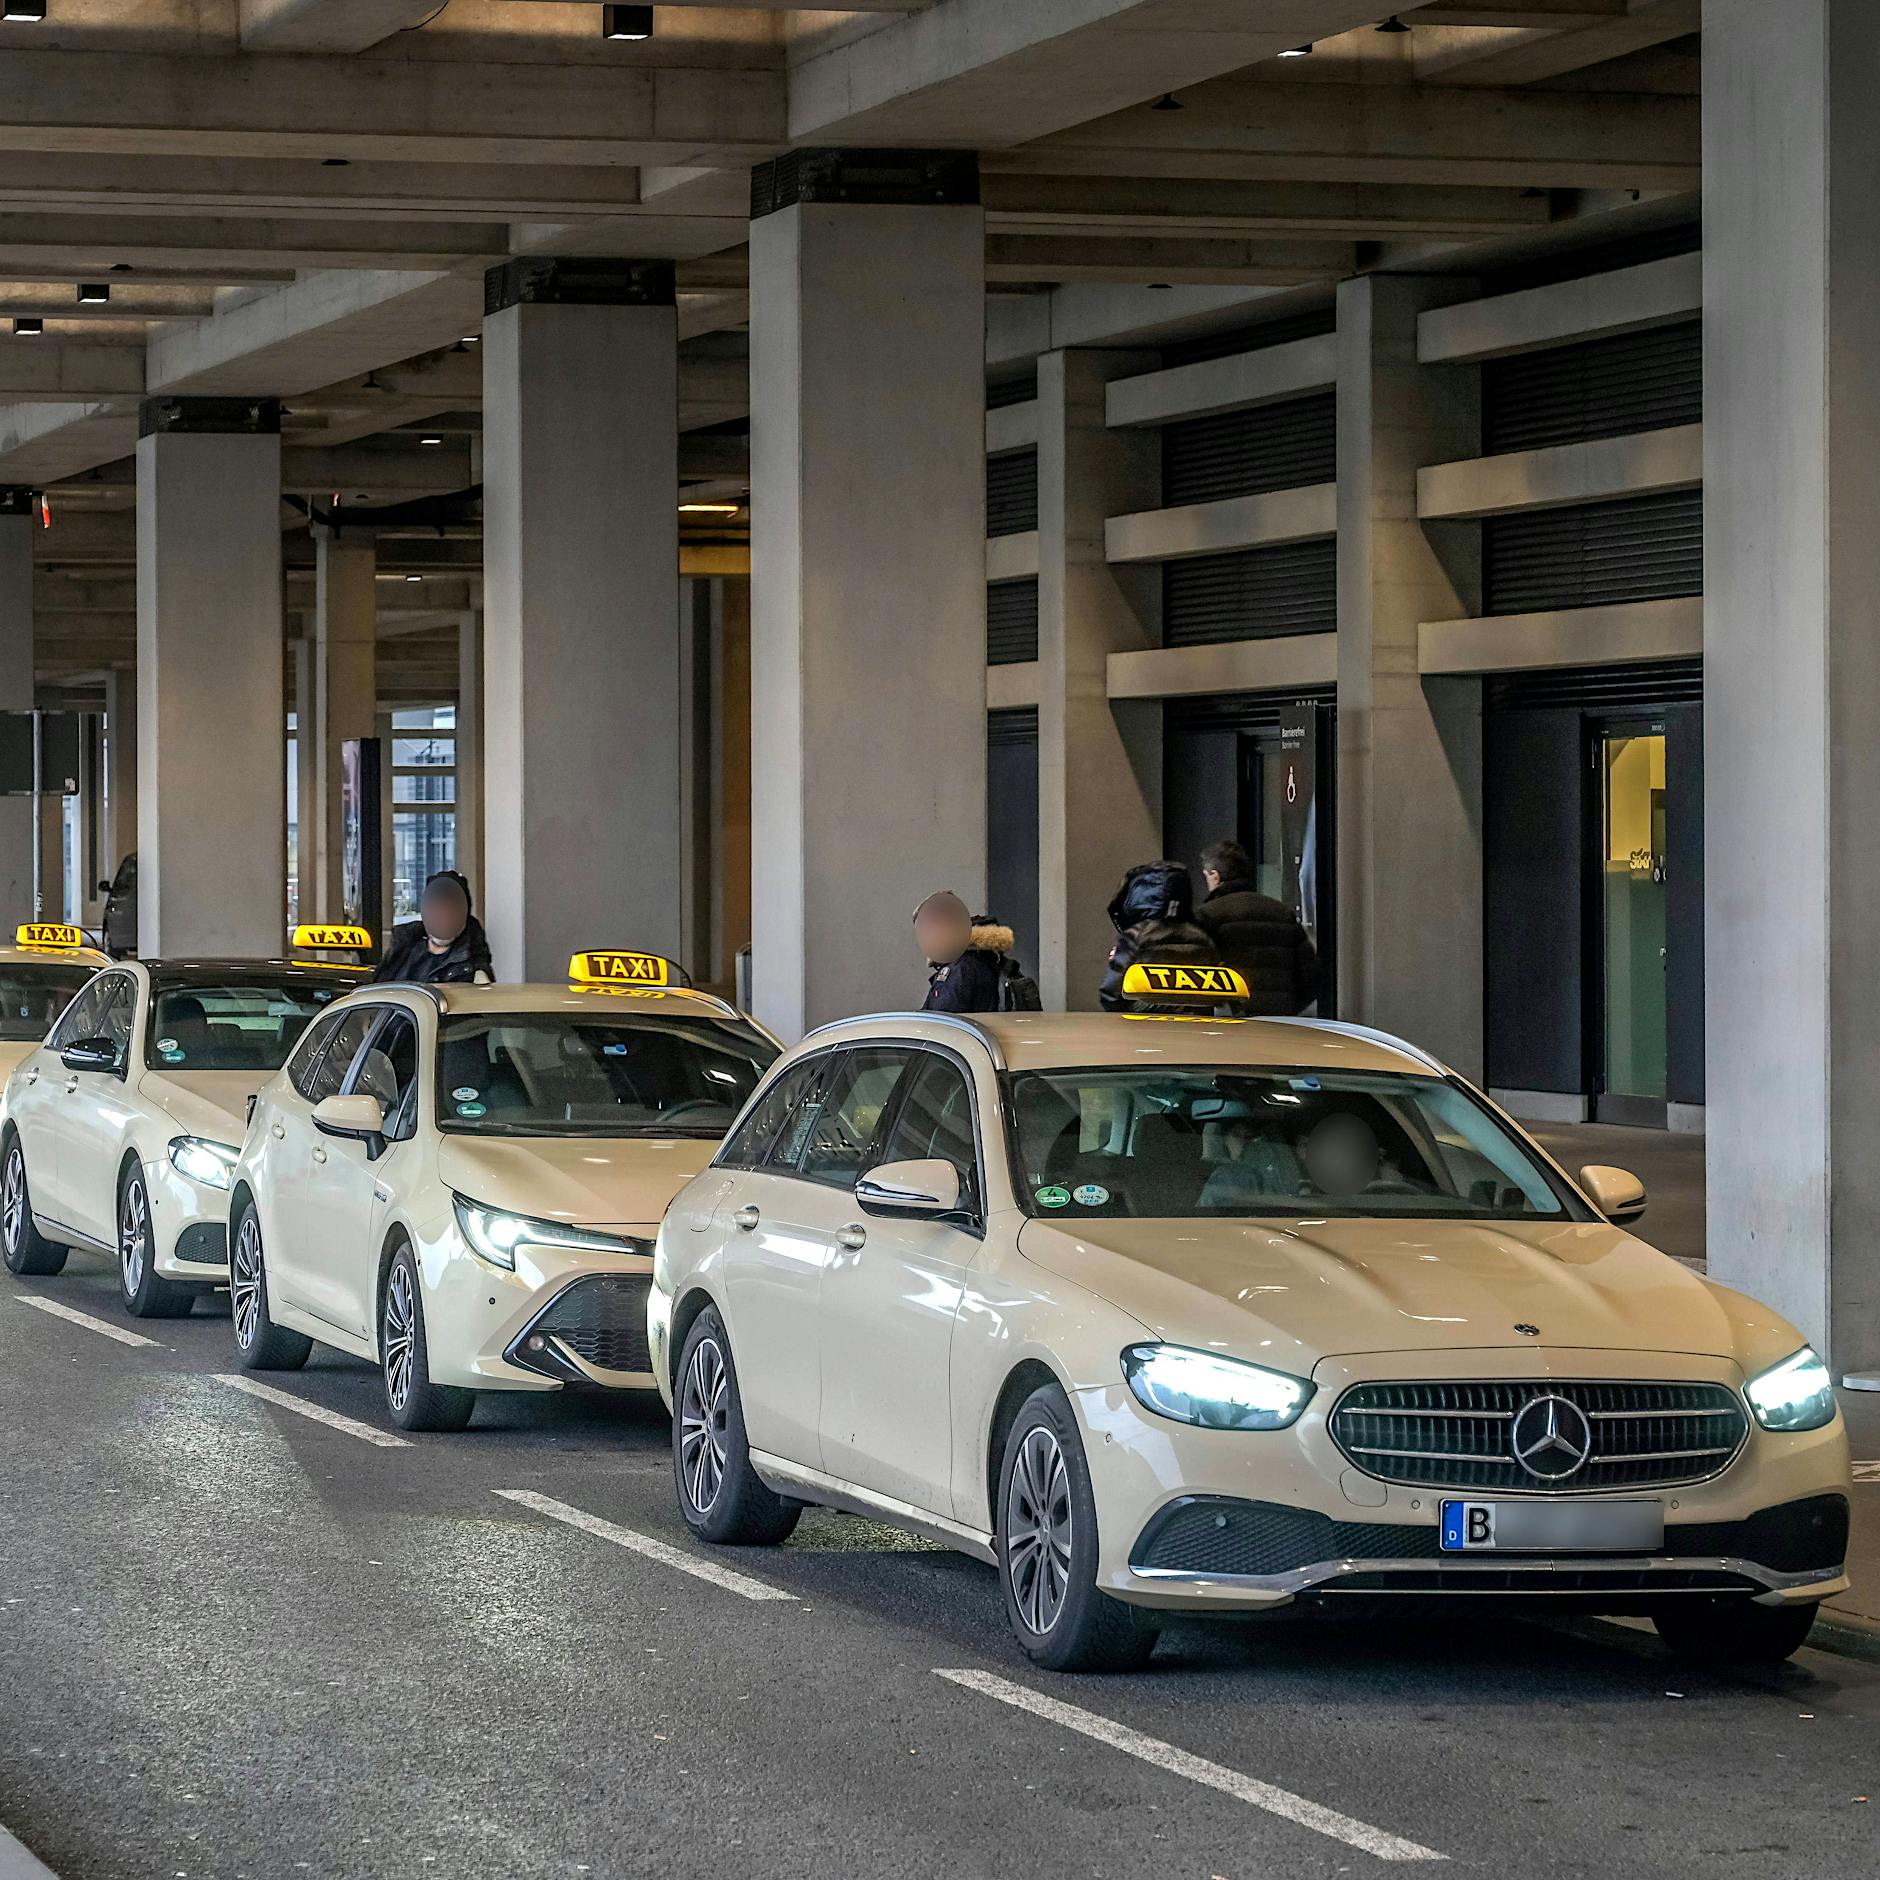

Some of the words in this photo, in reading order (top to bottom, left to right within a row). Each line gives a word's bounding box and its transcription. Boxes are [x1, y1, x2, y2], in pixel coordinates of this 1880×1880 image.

[31, 926, 72, 942] TAXI
[308, 930, 362, 944] TAXI
[593, 956, 655, 979] TAXI
[1148, 968, 1232, 991] TAXI
[1469, 1507, 1490, 1543] B
[1449, 1530, 1457, 1541] D
